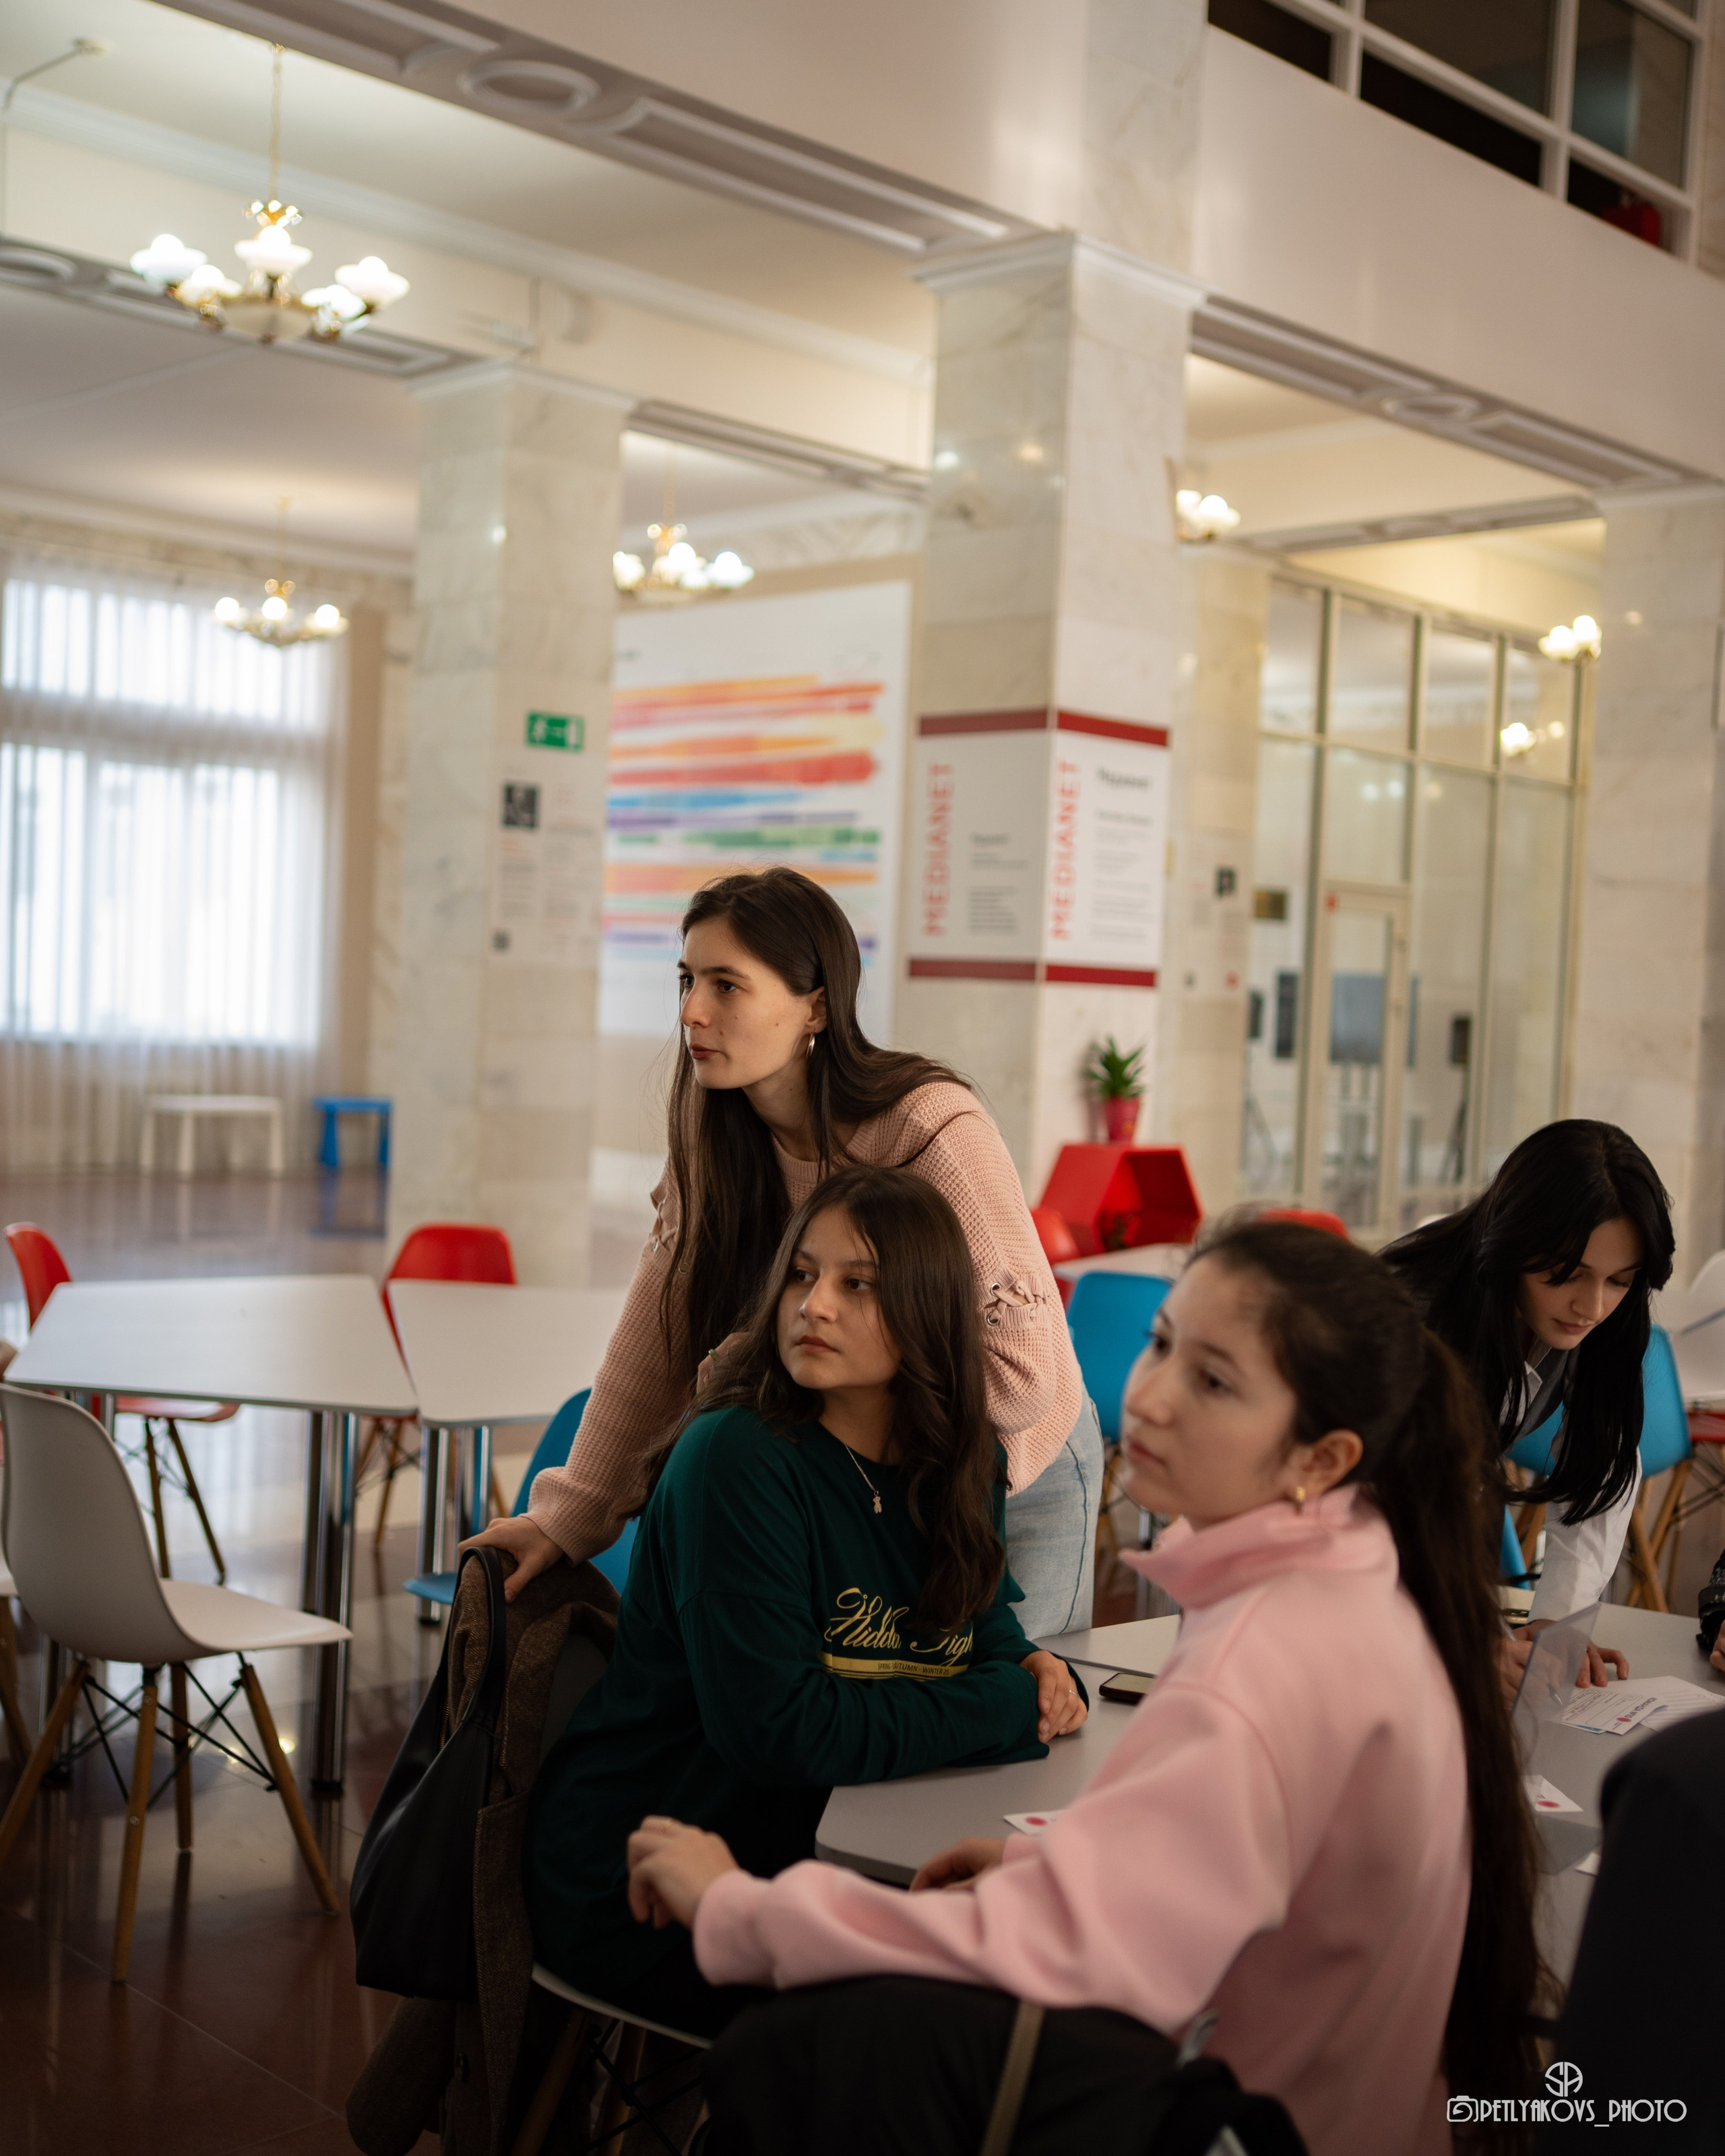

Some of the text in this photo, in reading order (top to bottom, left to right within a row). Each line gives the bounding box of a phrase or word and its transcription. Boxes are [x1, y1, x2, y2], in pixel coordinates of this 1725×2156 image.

[923, 762, 954, 937] MEDIANET
[1051, 761, 1081, 940] MEDIANET
[922, 1666, 943, 1675] WINTER
